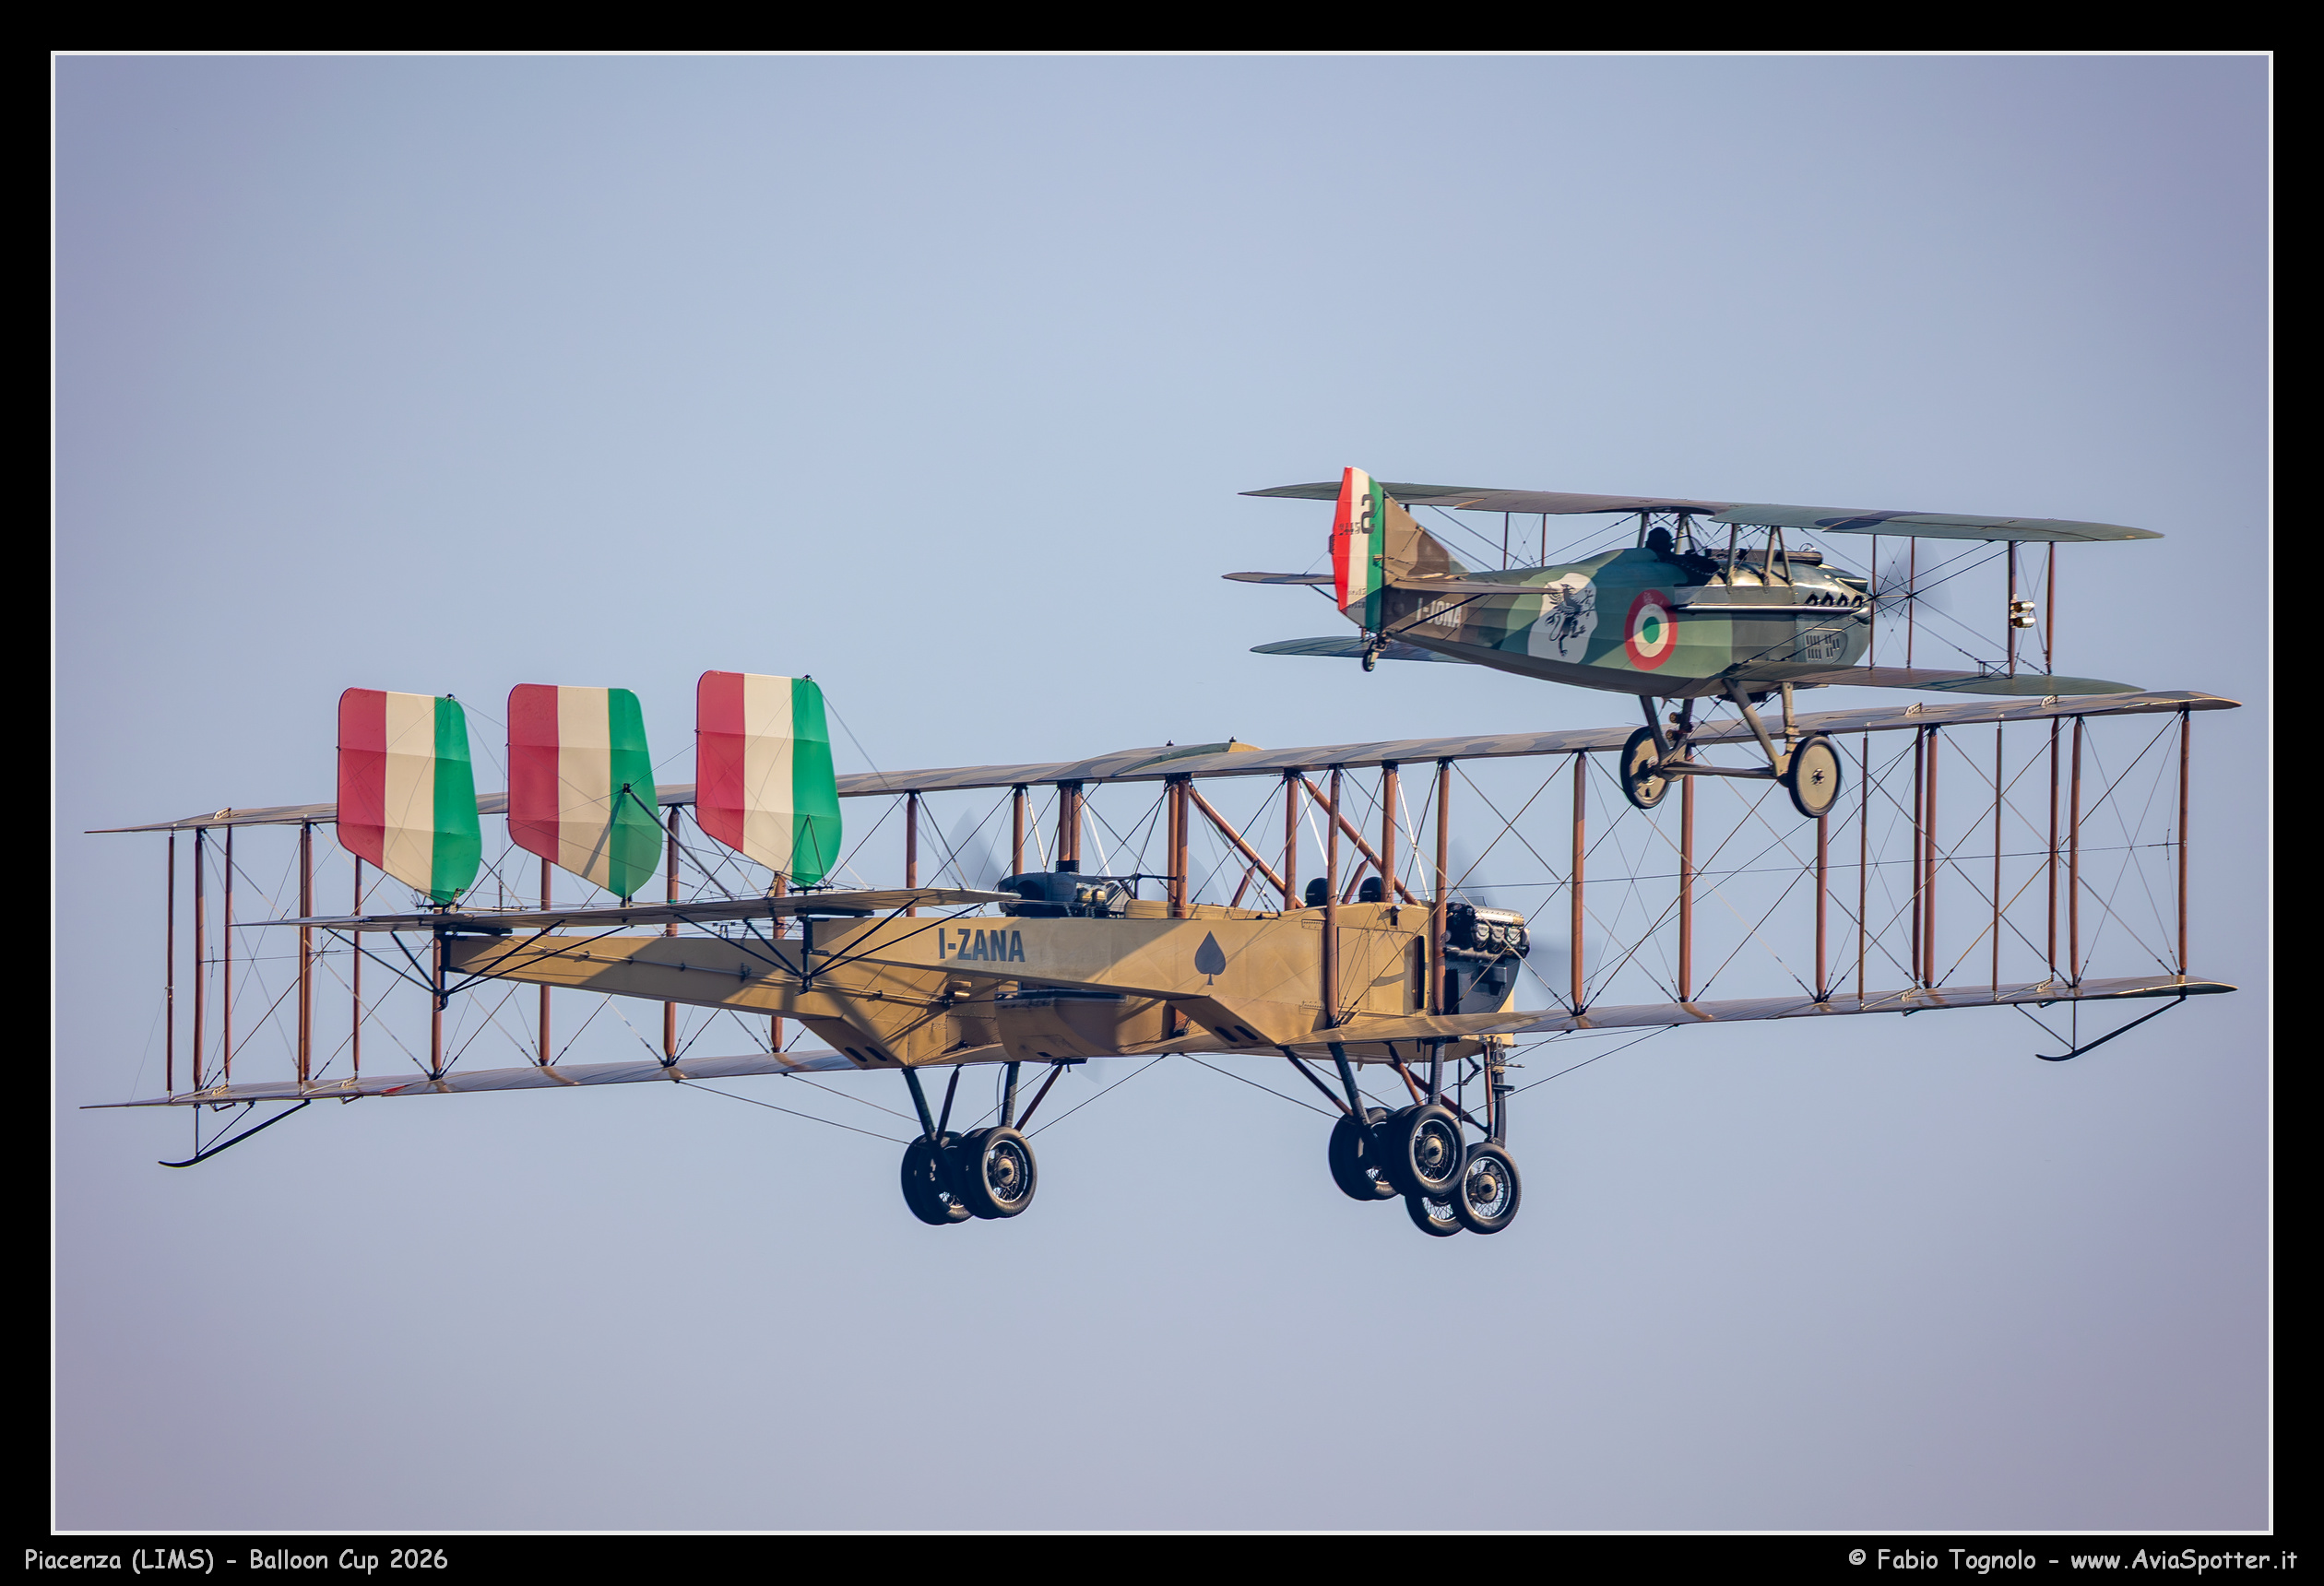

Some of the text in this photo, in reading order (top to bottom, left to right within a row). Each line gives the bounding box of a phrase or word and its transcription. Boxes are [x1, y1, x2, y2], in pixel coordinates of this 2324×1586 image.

[1361, 493, 1375, 534] 2
[1416, 598, 1463, 627] I-JONA
[939, 928, 1026, 962] I-ZANA
